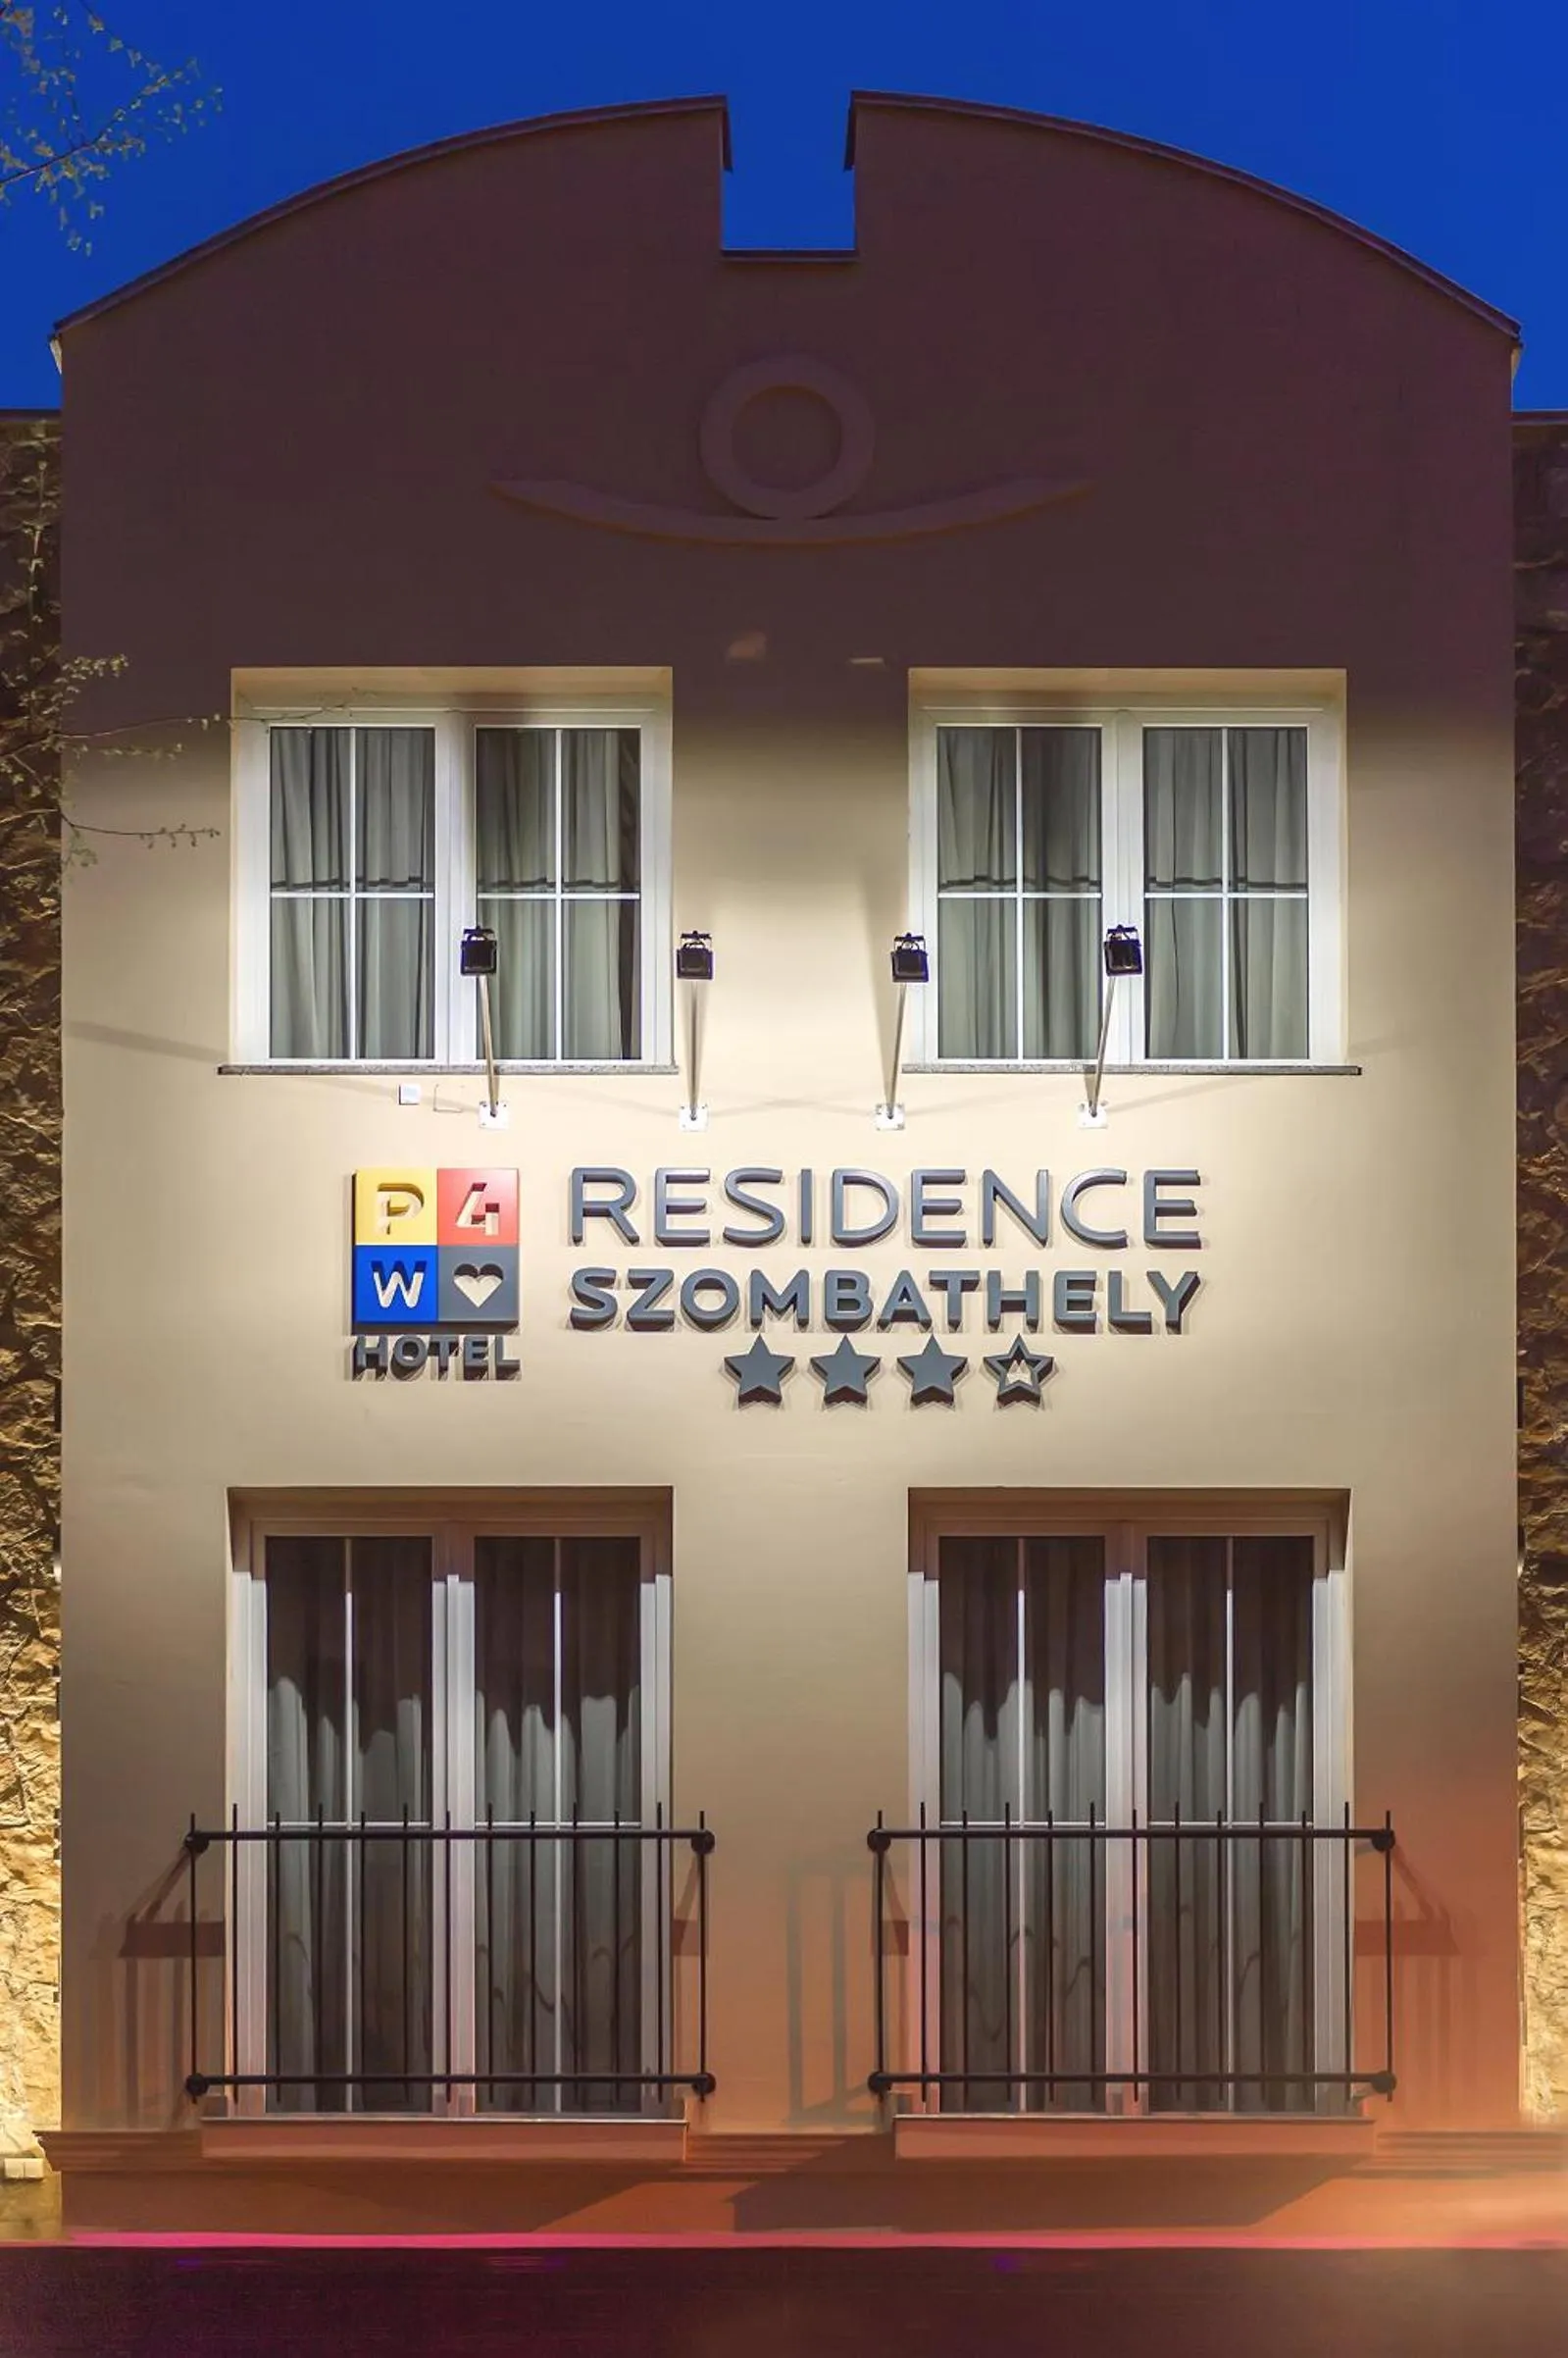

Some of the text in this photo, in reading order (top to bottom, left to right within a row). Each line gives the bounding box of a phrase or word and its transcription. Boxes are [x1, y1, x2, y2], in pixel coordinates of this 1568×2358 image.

[456, 1182, 500, 1236] 4
[570, 1167, 1202, 1249] RESIDENCE
[371, 1260, 428, 1308] W
[569, 1268, 1202, 1333] SZOMBATHELY
[352, 1335, 522, 1381] HOTEL
